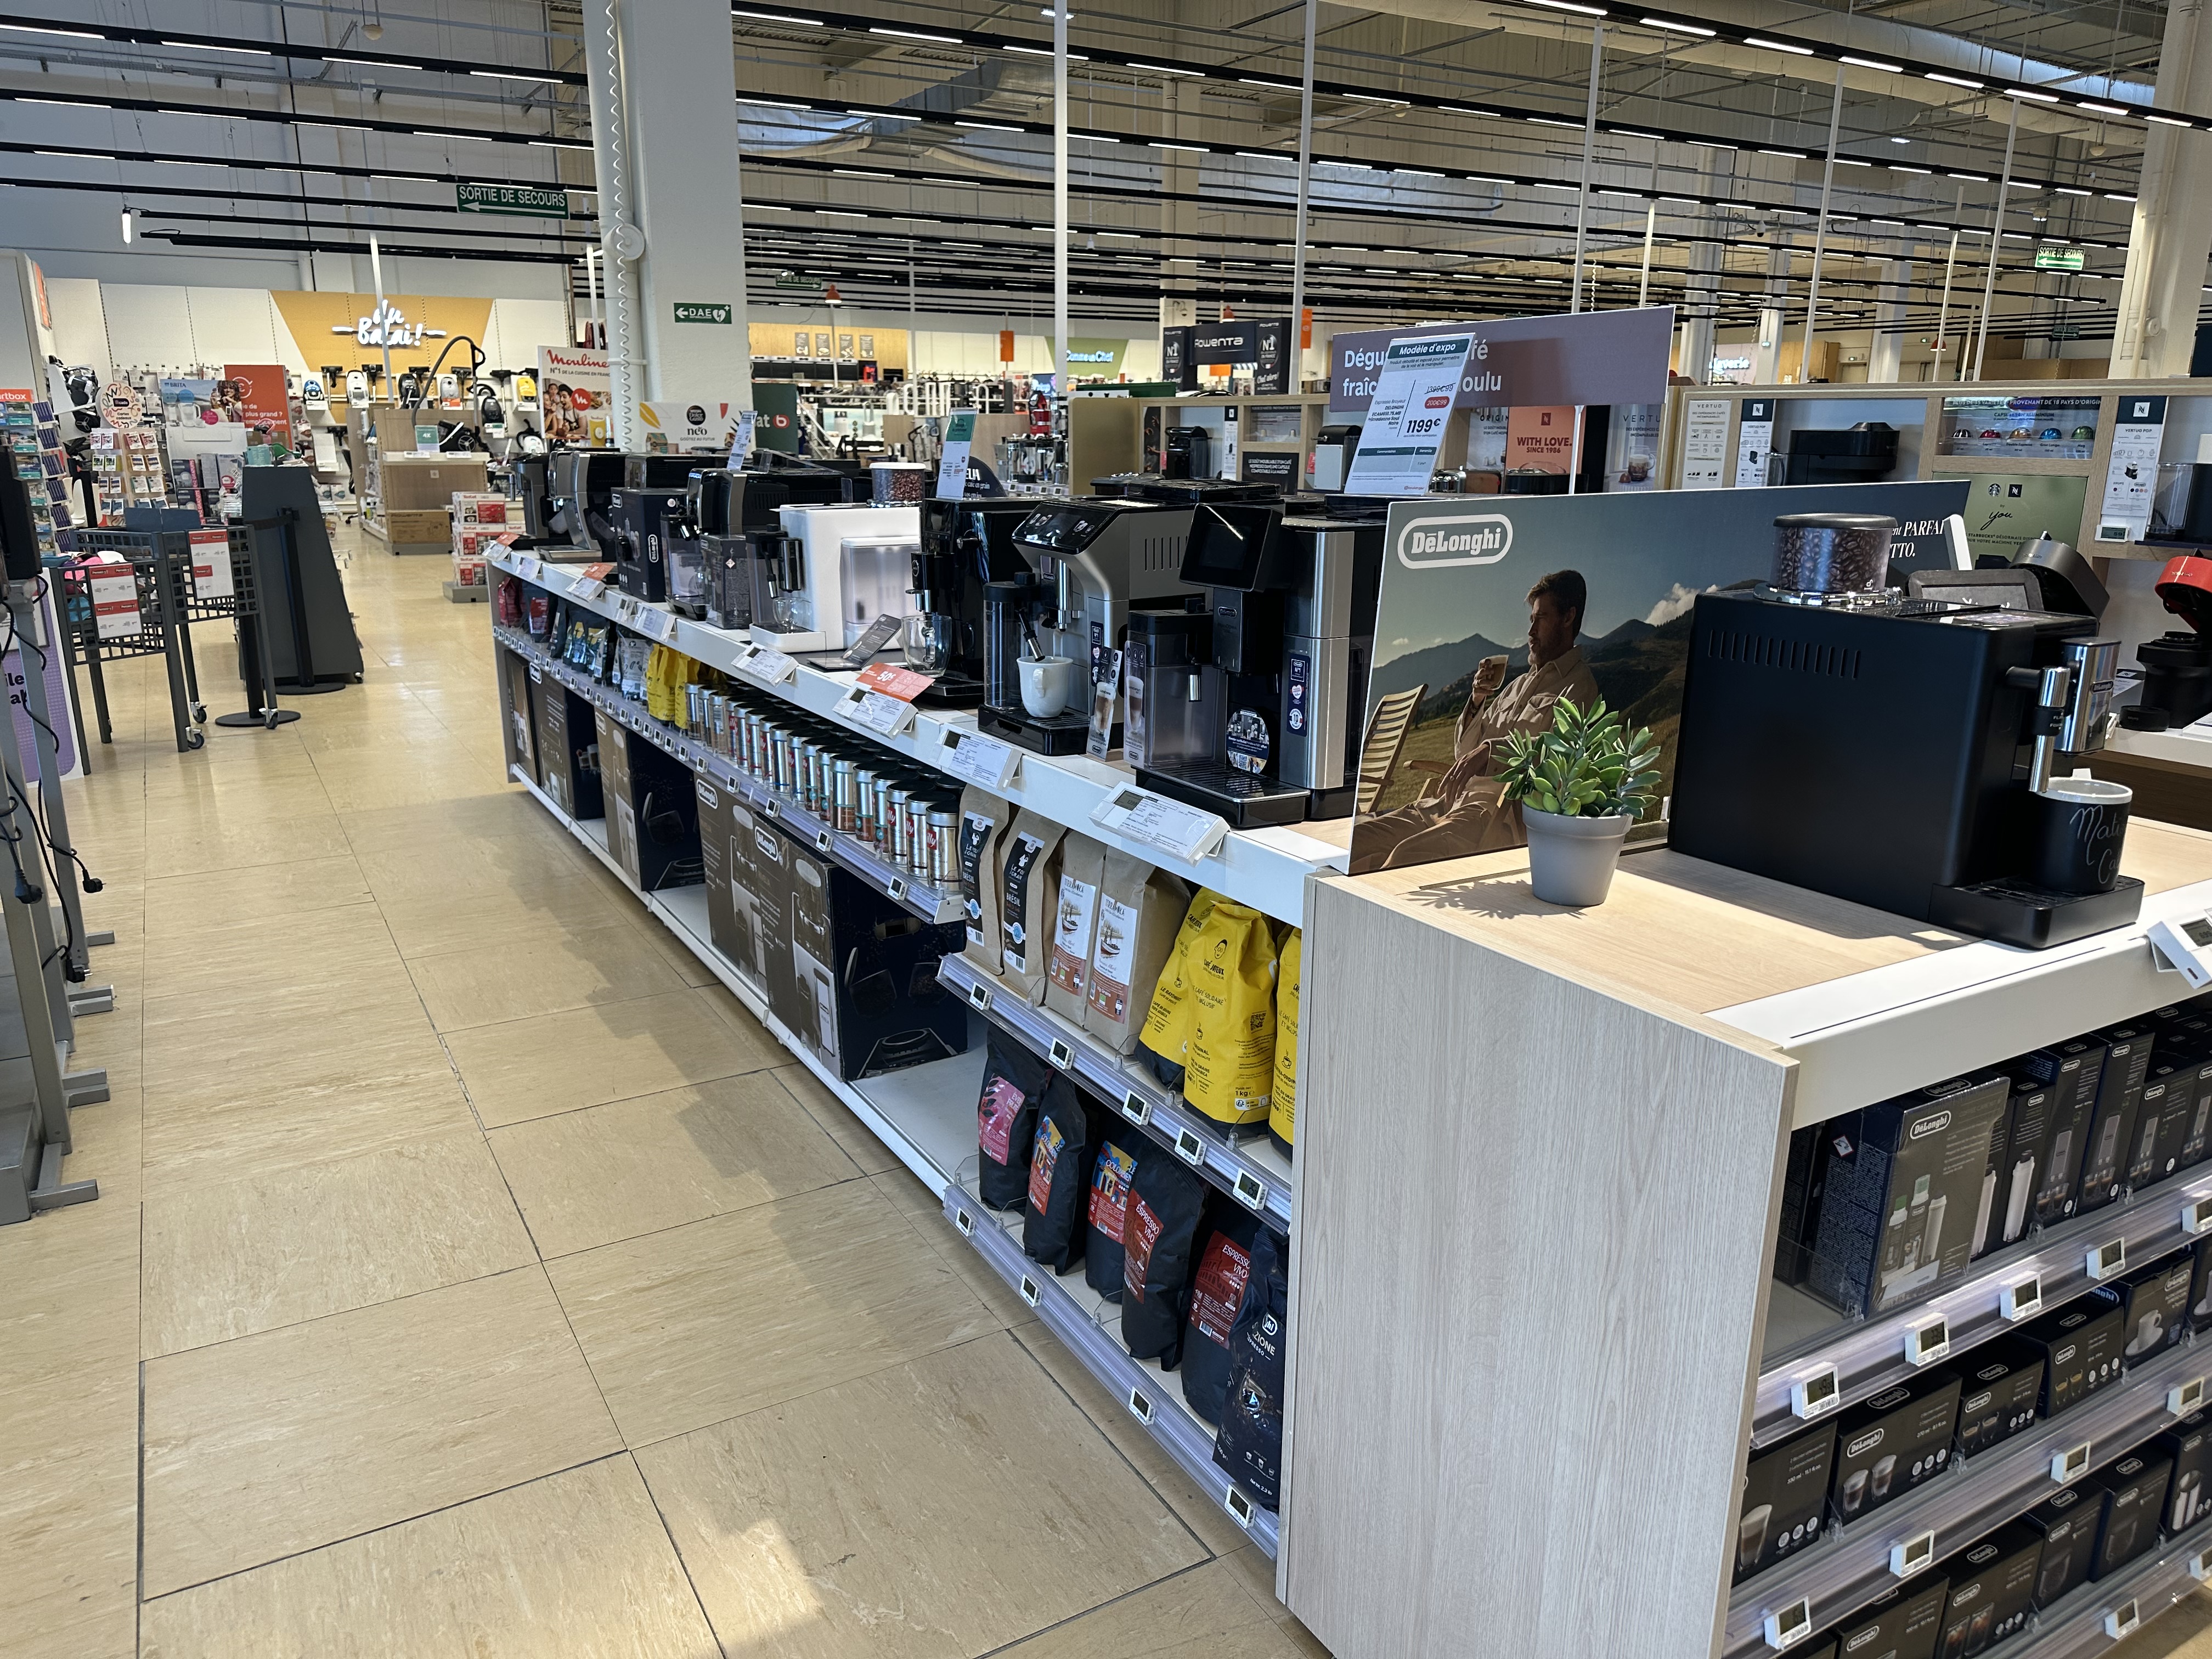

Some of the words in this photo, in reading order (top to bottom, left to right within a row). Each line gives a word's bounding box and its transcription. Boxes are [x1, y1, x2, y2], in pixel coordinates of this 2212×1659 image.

[459, 186, 498, 201] SORTIE
[500, 189, 515, 202] DE
[518, 191, 566, 207] SECOURS
[2039, 247, 2057, 257] SORTIE
[2057, 249, 2063, 258] DE
[2064, 249, 2084, 259] SECOURS
[689, 308, 712, 317] DAE
[1096, 351, 1114, 362] Chef
[1344, 348, 1388, 371] Dégu
[1467, 339, 1488, 360] fé
[1399, 344, 1427, 356] Modèle
[1429, 343, 1456, 353] d'expo
[1343, 377, 1379, 397] fraîc
[1517, 437, 1543, 446] WITH
[1544, 437, 1572, 447] LOVE.
[1980, 511, 2013, 531] you
[2069, 805, 2122, 866] Mati
[1006, 891, 1020, 907] BRÉSIL
[1136, 1203, 1159, 1234] ESPRESSO
[1144, 1226, 1155, 1243] VIVO
[1222, 1244, 1250, 1269] ESPRESSO
[1233, 1263, 1248, 1278] VIVO
